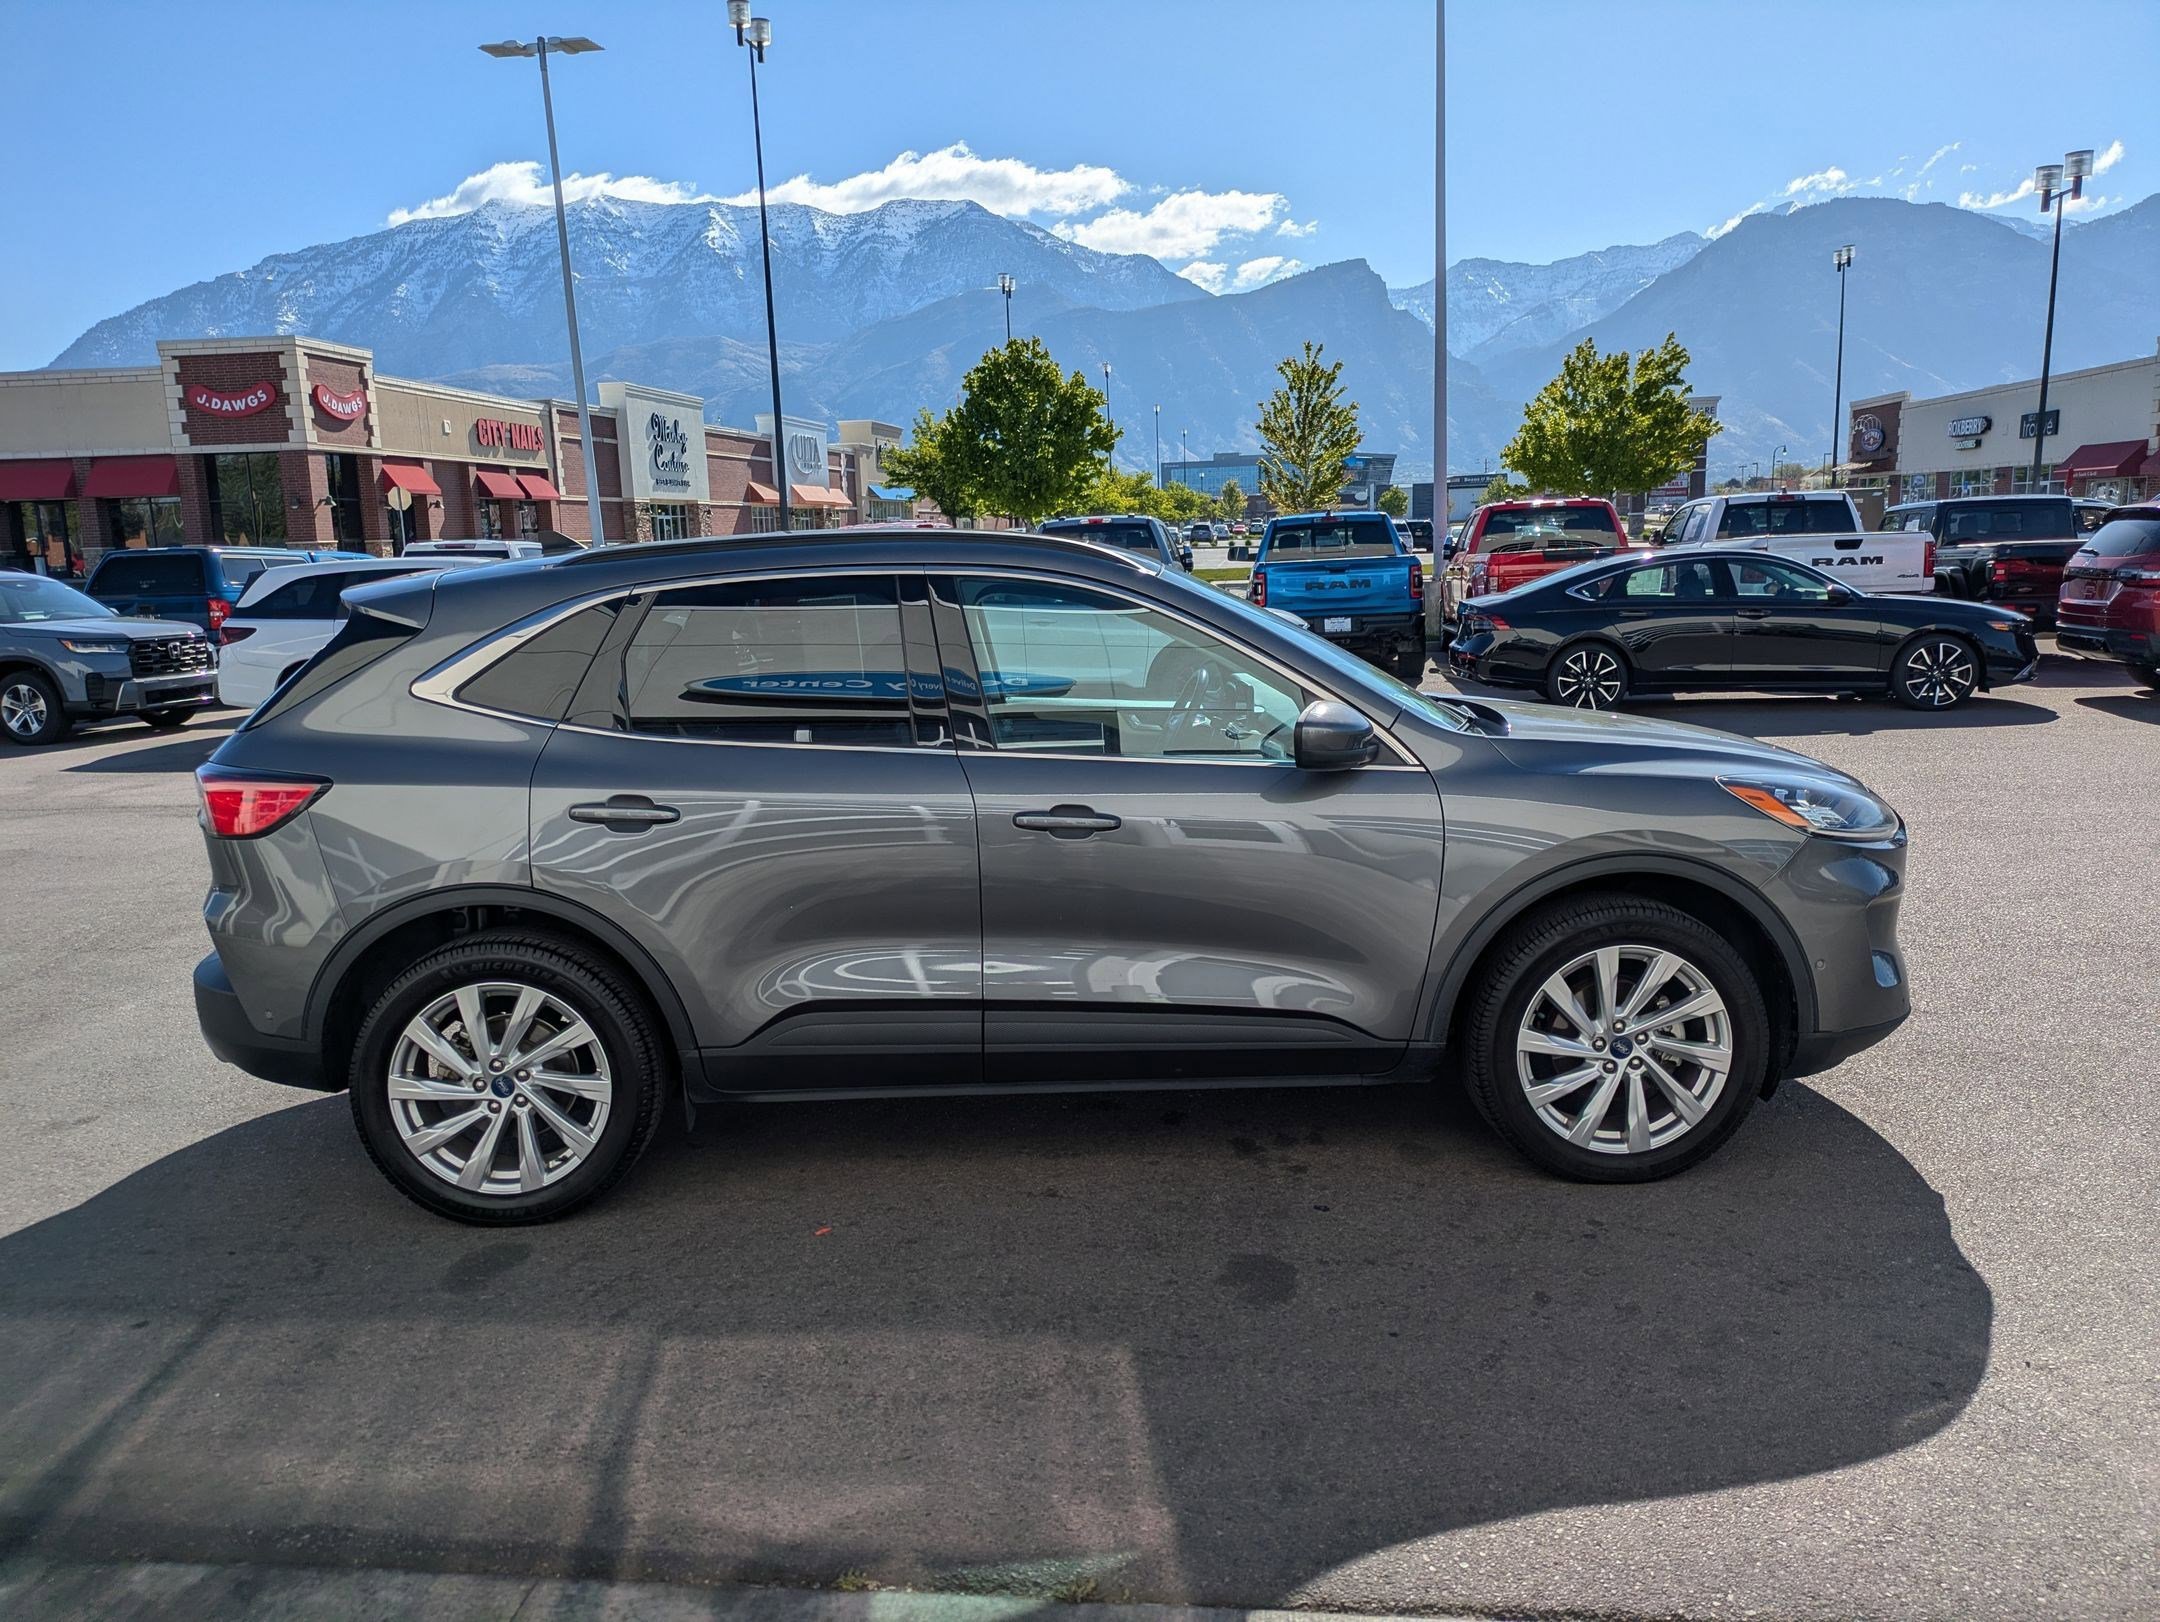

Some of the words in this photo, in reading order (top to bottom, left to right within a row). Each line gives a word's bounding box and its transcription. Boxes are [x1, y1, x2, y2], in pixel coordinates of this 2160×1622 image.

[197, 389, 267, 412] J.DAWGS
[322, 394, 363, 414] J.DAWGS
[477, 418, 506, 447] CITY
[510, 423, 545, 451] NAILS
[1947, 417, 1983, 436] ROXBERRY
[1812, 556, 1883, 566] RAM
[1305, 579, 1371, 591] RAM
[471, 961, 552, 979] MICHELIN
